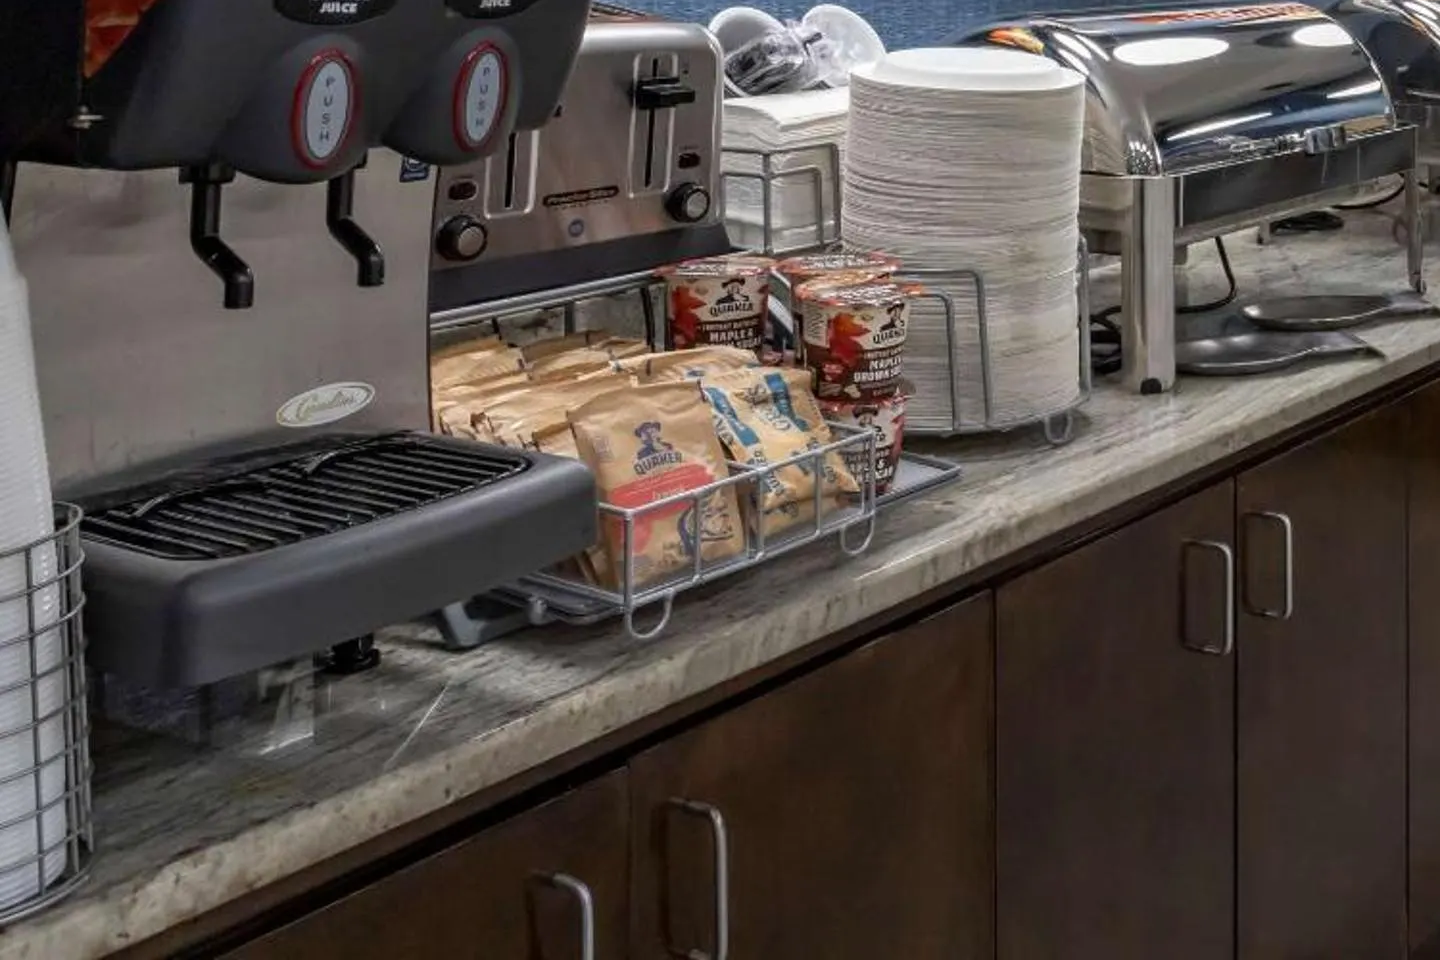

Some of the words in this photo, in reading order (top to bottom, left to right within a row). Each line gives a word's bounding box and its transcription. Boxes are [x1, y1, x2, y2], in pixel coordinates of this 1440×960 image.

[319, 2, 358, 14] JUICE
[318, 76, 337, 142] PUSH
[475, 66, 492, 128] PUSH
[710, 301, 754, 317] QUAKER
[633, 450, 684, 475] QUAKER
